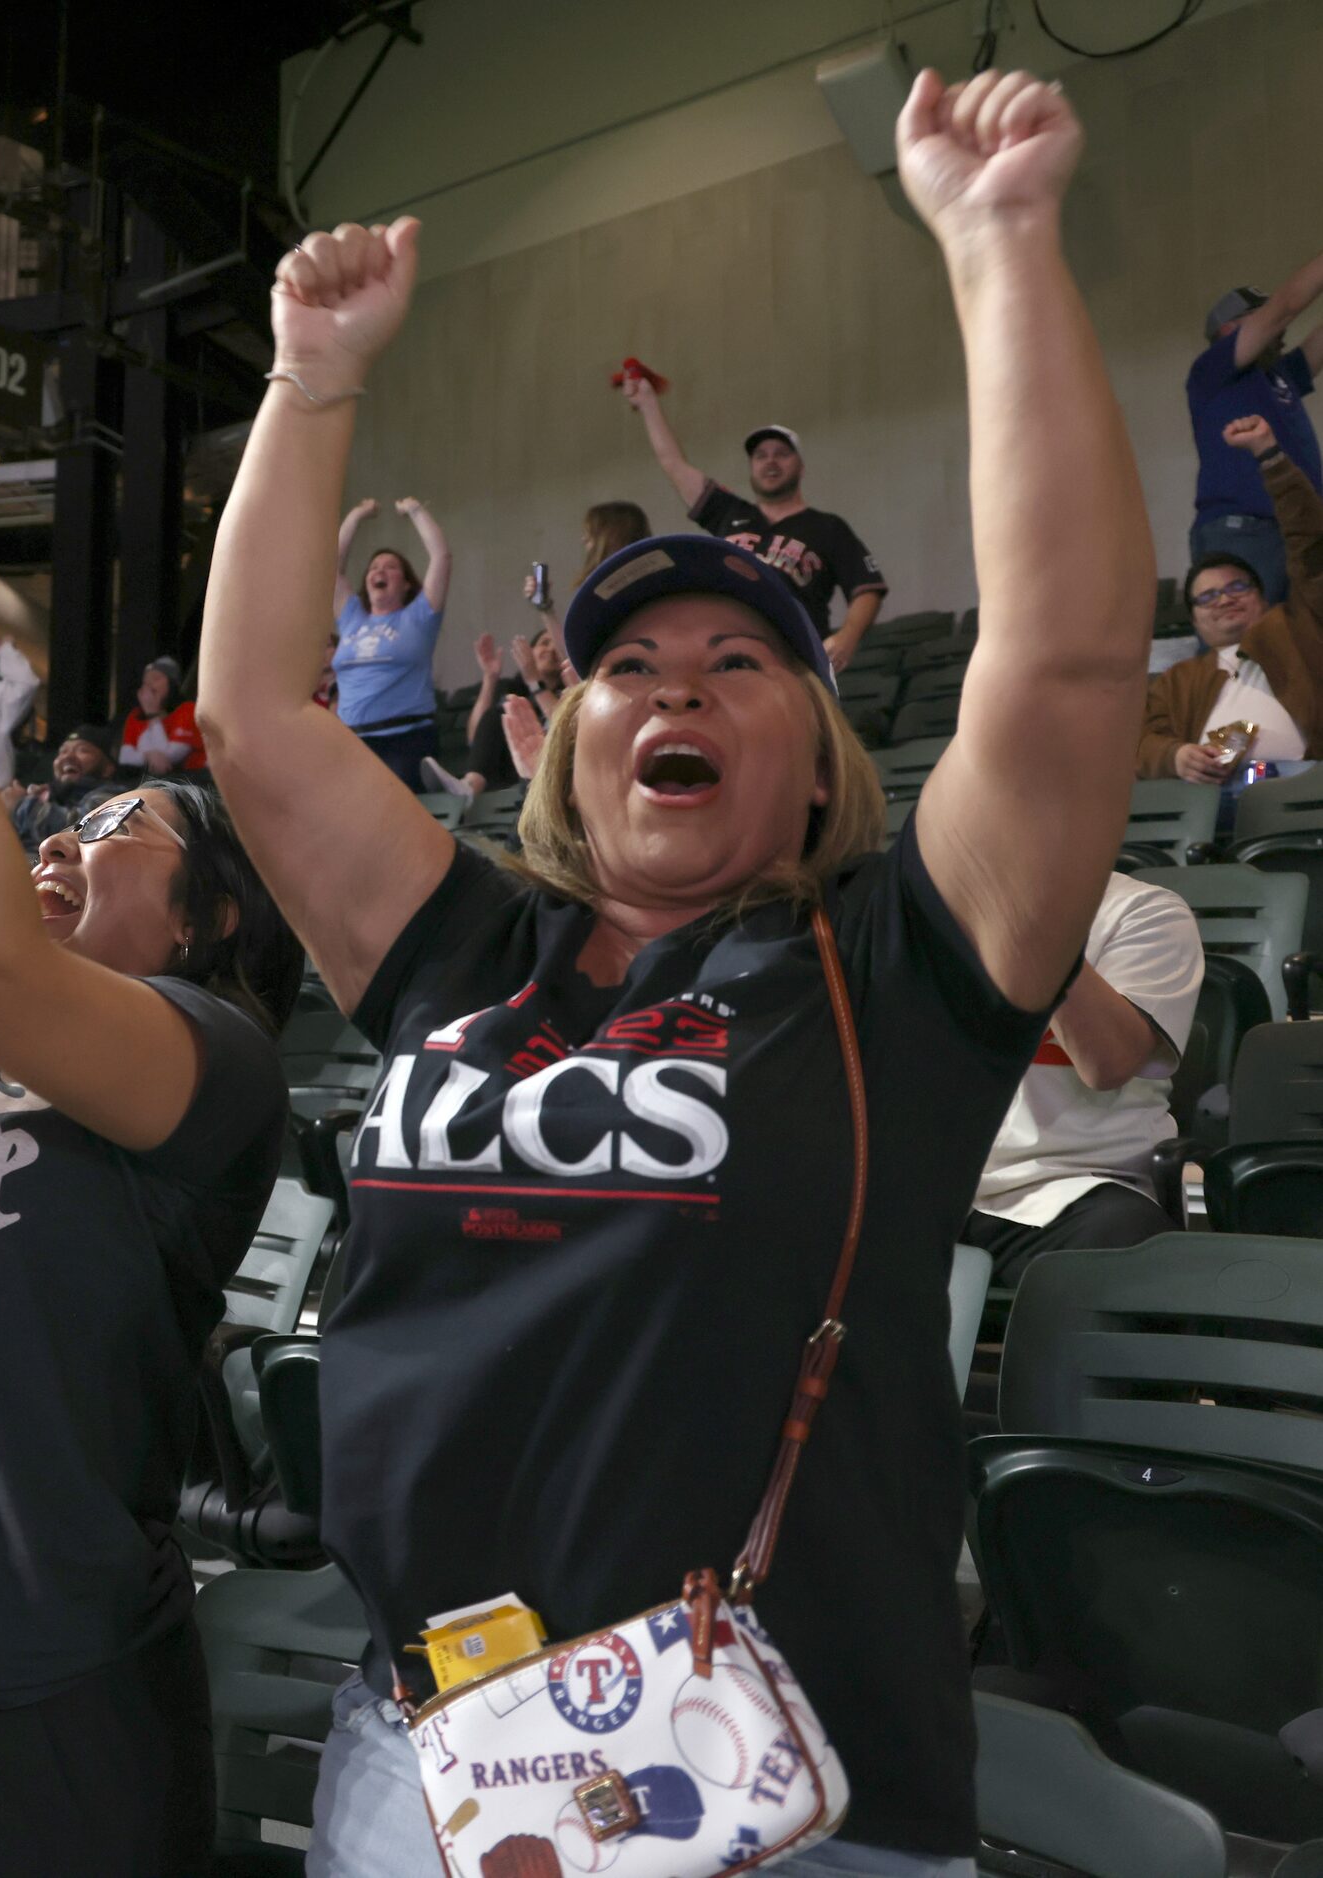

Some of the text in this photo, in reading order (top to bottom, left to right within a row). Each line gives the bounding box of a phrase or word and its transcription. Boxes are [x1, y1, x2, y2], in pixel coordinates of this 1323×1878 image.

[351, 1054, 730, 1179] ALCS
[1142, 1468, 1152, 1482] 4
[576, 1658, 613, 1705] T
[553, 1686, 640, 1731] RANGERS
[470, 1749, 609, 1789] RANGERS
